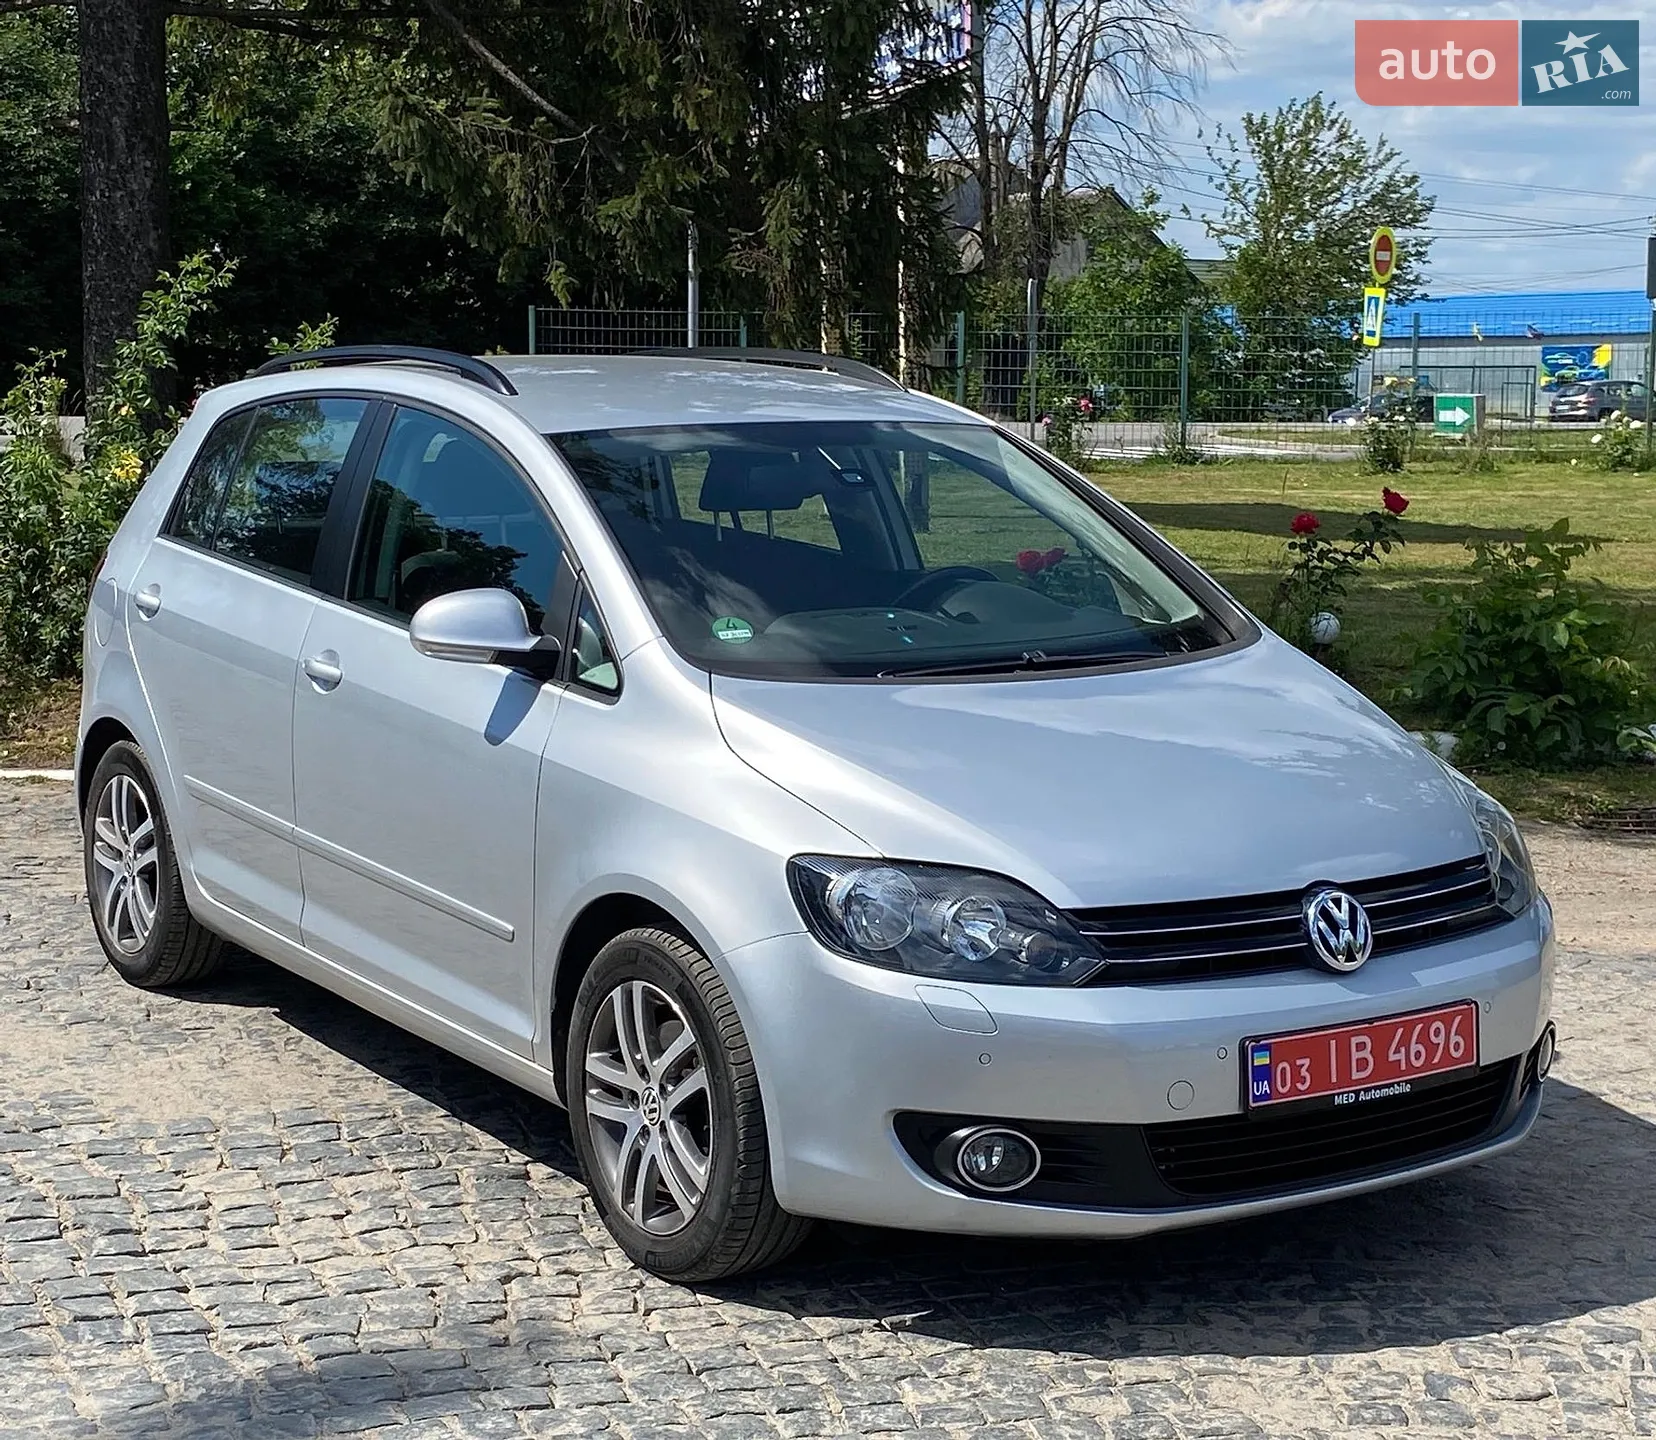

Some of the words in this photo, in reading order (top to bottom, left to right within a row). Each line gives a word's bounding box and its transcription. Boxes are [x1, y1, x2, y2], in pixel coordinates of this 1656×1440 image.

[726, 618, 738, 630] 4
[1275, 1057, 1311, 1094] 03
[1387, 1015, 1465, 1071] 4696
[1253, 1079, 1271, 1096] UA
[1334, 1092, 1356, 1106] MED
[1358, 1082, 1412, 1102] Automobile
